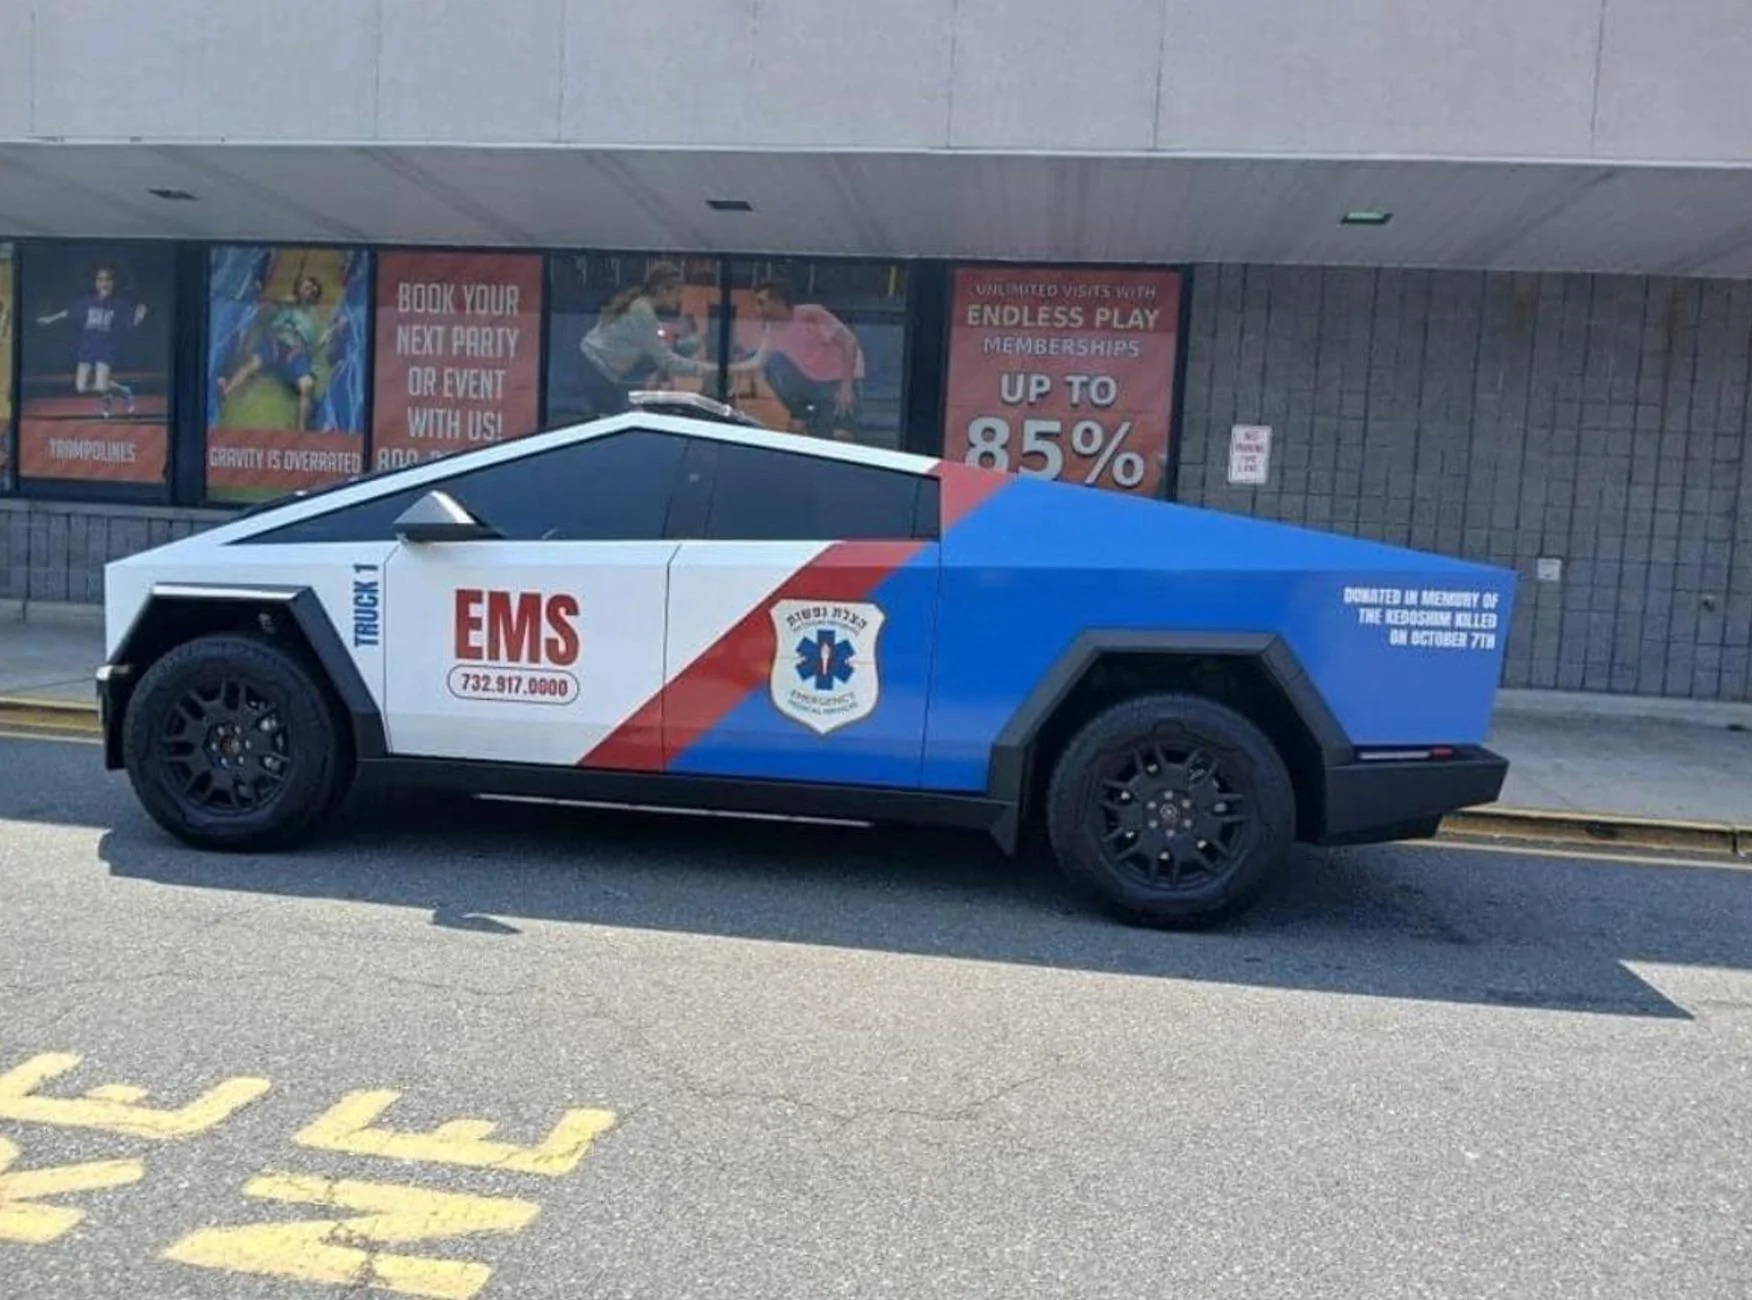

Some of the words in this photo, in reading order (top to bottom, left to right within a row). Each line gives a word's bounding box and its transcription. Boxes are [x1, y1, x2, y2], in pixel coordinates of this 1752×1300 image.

[397, 282, 455, 314] BOOK
[463, 284, 520, 316] YOUR
[976, 283, 1058, 297] UNLIMITED
[1064, 284, 1110, 298] VISITS
[1116, 286, 1157, 299] WITH
[967, 304, 1084, 326] ENDLESS
[1095, 307, 1160, 330] PLAY
[396, 325, 444, 354] NEXT
[451, 327, 521, 358] PARTY
[984, 337, 1141, 357] MEMBERSHIPS
[408, 367, 436, 396] OR
[443, 368, 507, 400] EVENT
[1001, 374, 1050, 403] UP
[1065, 375, 1118, 406] TO
[408, 408, 460, 440] WITH
[467, 411, 504, 442] US!
[49, 438, 137, 463] TRAMPOLINES
[209, 448, 263, 470] GRAVITY
[267, 450, 281, 470] IS
[284, 450, 362, 474] OVERRATED
[965, 416, 1144, 488] 85%
[353, 563, 379, 573] 1
[1344, 587, 1401, 604] DONATED
[1404, 590, 1418, 605] IN
[1421, 590, 1480, 608] MEMORY
[1483, 592, 1499, 609] OF
[353, 580, 379, 648] TRUCK
[454, 588, 581, 666] EMS
[1359, 608, 1384, 624] THE
[1454, 612, 1497, 629] KILLED
[1390, 630, 1407, 646] ON
[1411, 631, 1468, 648] OCTOBER
[1471, 632, 1495, 649] 7TH
[461, 673, 569, 698] 732.917.0000
